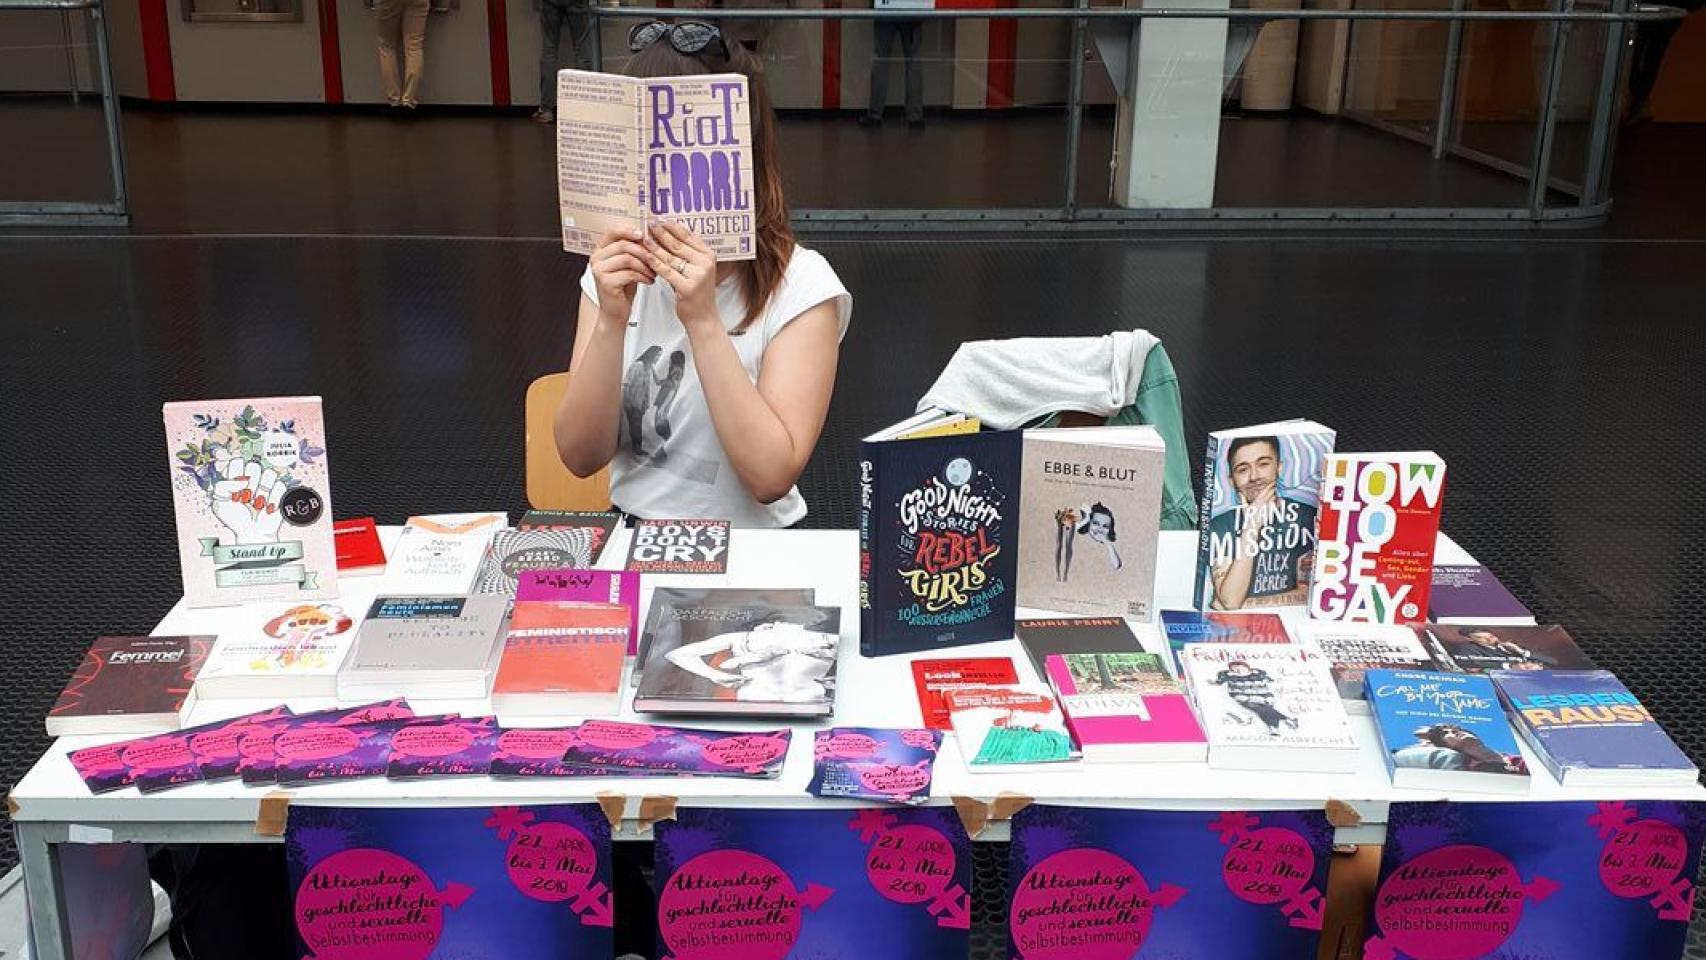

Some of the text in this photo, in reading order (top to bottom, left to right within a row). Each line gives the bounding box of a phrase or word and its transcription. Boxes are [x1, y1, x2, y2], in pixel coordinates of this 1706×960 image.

[649, 151, 749, 215] GRRRL
[677, 214, 750, 235] VISITED
[1044, 461, 1137, 482] EBBE & BLUT
[1325, 460, 1445, 508] HOW
[901, 476, 947, 534] GOOD
[1235, 498, 1300, 531] TRANS
[640, 525, 726, 536] BOYS
[1330, 502, 1397, 546] TO
[636, 536, 727, 546] DON'T
[915, 526, 996, 573] REBEL
[230, 546, 286, 559] Stand Up
[633, 545, 726, 561] CRY
[1319, 542, 1380, 584] BE
[898, 604, 919, 621] 100
[1311, 584, 1412, 623] GAY
[508, 627, 628, 637] FEMINISTISCH
[1021, 619, 1120, 628] LAURIE PENNY
[1514, 692, 1640, 709] LESBEN
[1522, 705, 1654, 726] RAUS!
[556, 856, 590, 873] Mai
[915, 859, 949, 875] Mai
[1272, 862, 1306, 879] Mai
[1645, 853, 1678, 870] Mai
[307, 870, 420, 889] Aktionstage
[671, 872, 778, 890] Aktionstage
[1026, 871, 1134, 890] Aktionstage
[1398, 864, 1508, 880] Aktionstage
[1384, 884, 1520, 907] geschlechtliche
[304, 893, 436, 922] geschlechtliche
[666, 894, 796, 924] geschlechtliche
[1018, 894, 1150, 924] geschlechtliche
[1404, 900, 1509, 914] und sexuelle
[328, 909, 427, 929] und sexuelle
[689, 910, 789, 930] und sexuelle
[1039, 910, 1138, 931] und sexuelle
[1383, 916, 1509, 936] Selbstbestimmung
[311, 930, 434, 948] Selbstbestimmung
[670, 931, 792, 949] Selbstbestimmung
[1020, 931, 1141, 950] Selbstbestimmung
